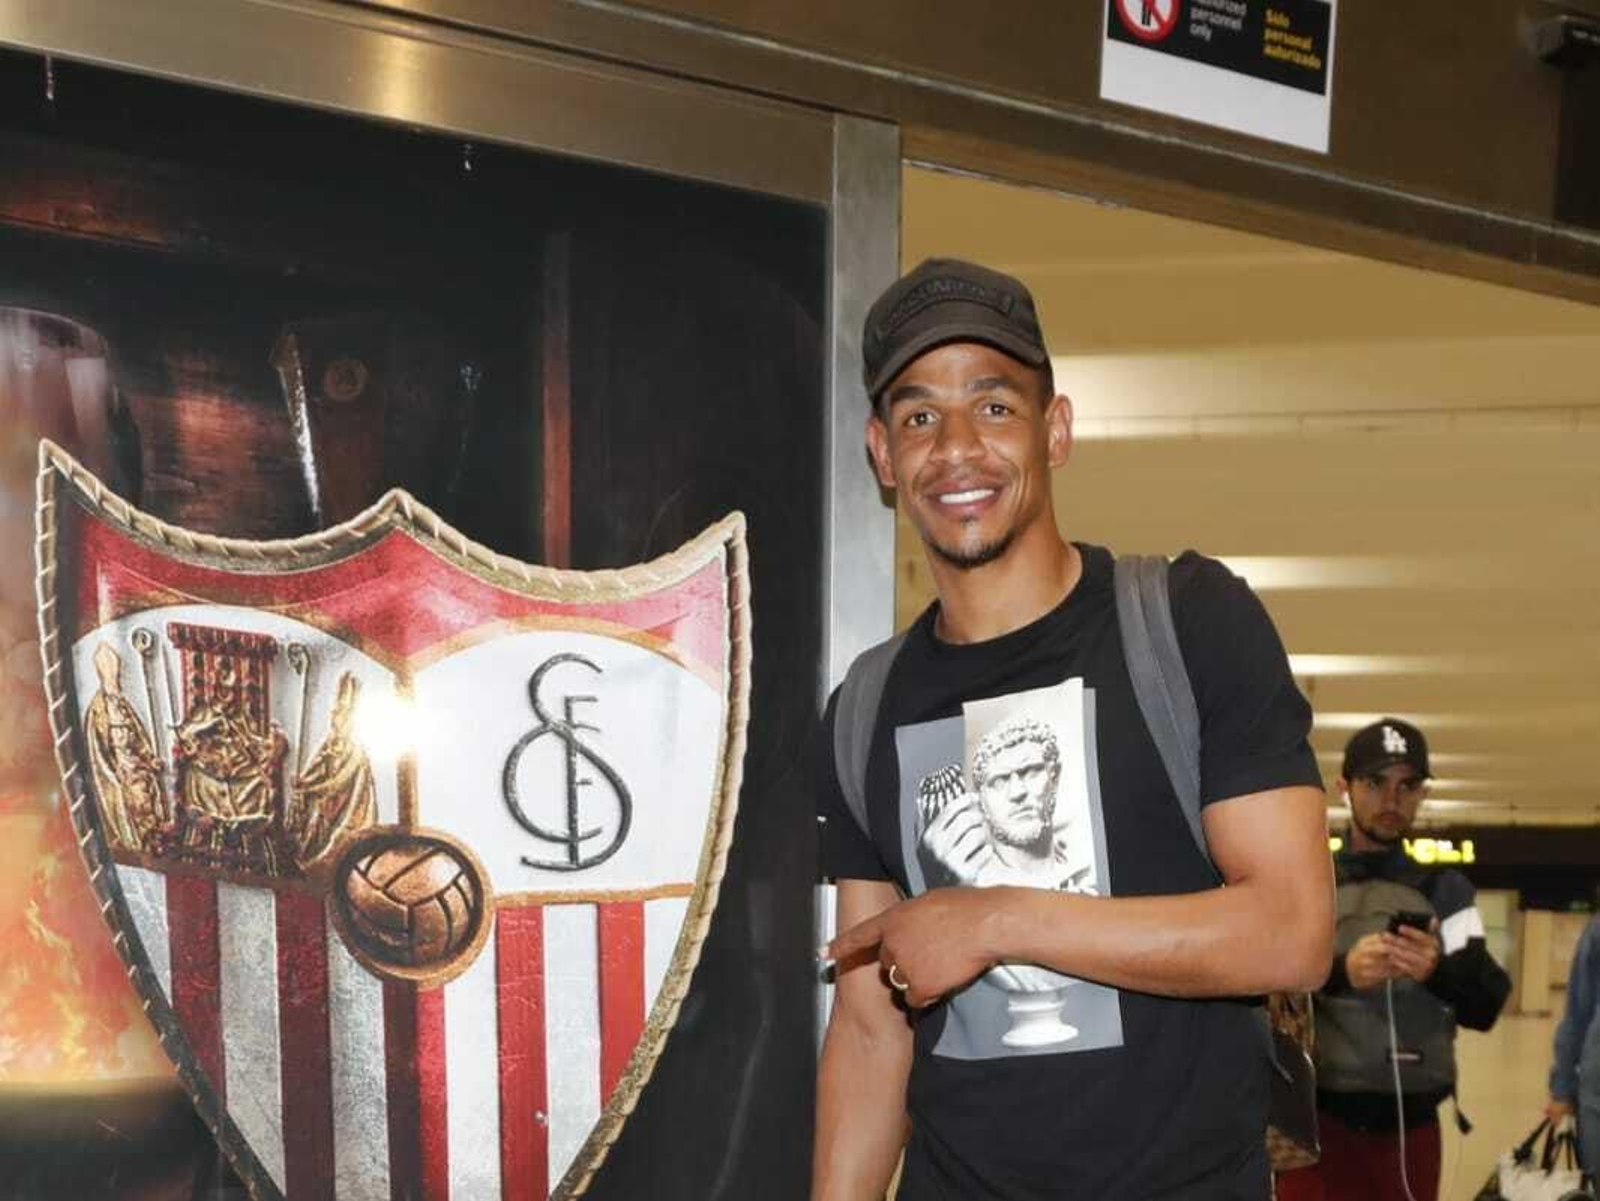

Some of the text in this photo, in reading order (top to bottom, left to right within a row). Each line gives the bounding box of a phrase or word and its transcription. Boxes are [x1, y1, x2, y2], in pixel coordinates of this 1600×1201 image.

[1190, 8, 1242, 30] personnel
[1190, 24, 1212, 41] only
[1264, 28, 1313, 50] personal
[1263, 45, 1321, 69] autorizado
[1382, 726, 1407, 753] LA
